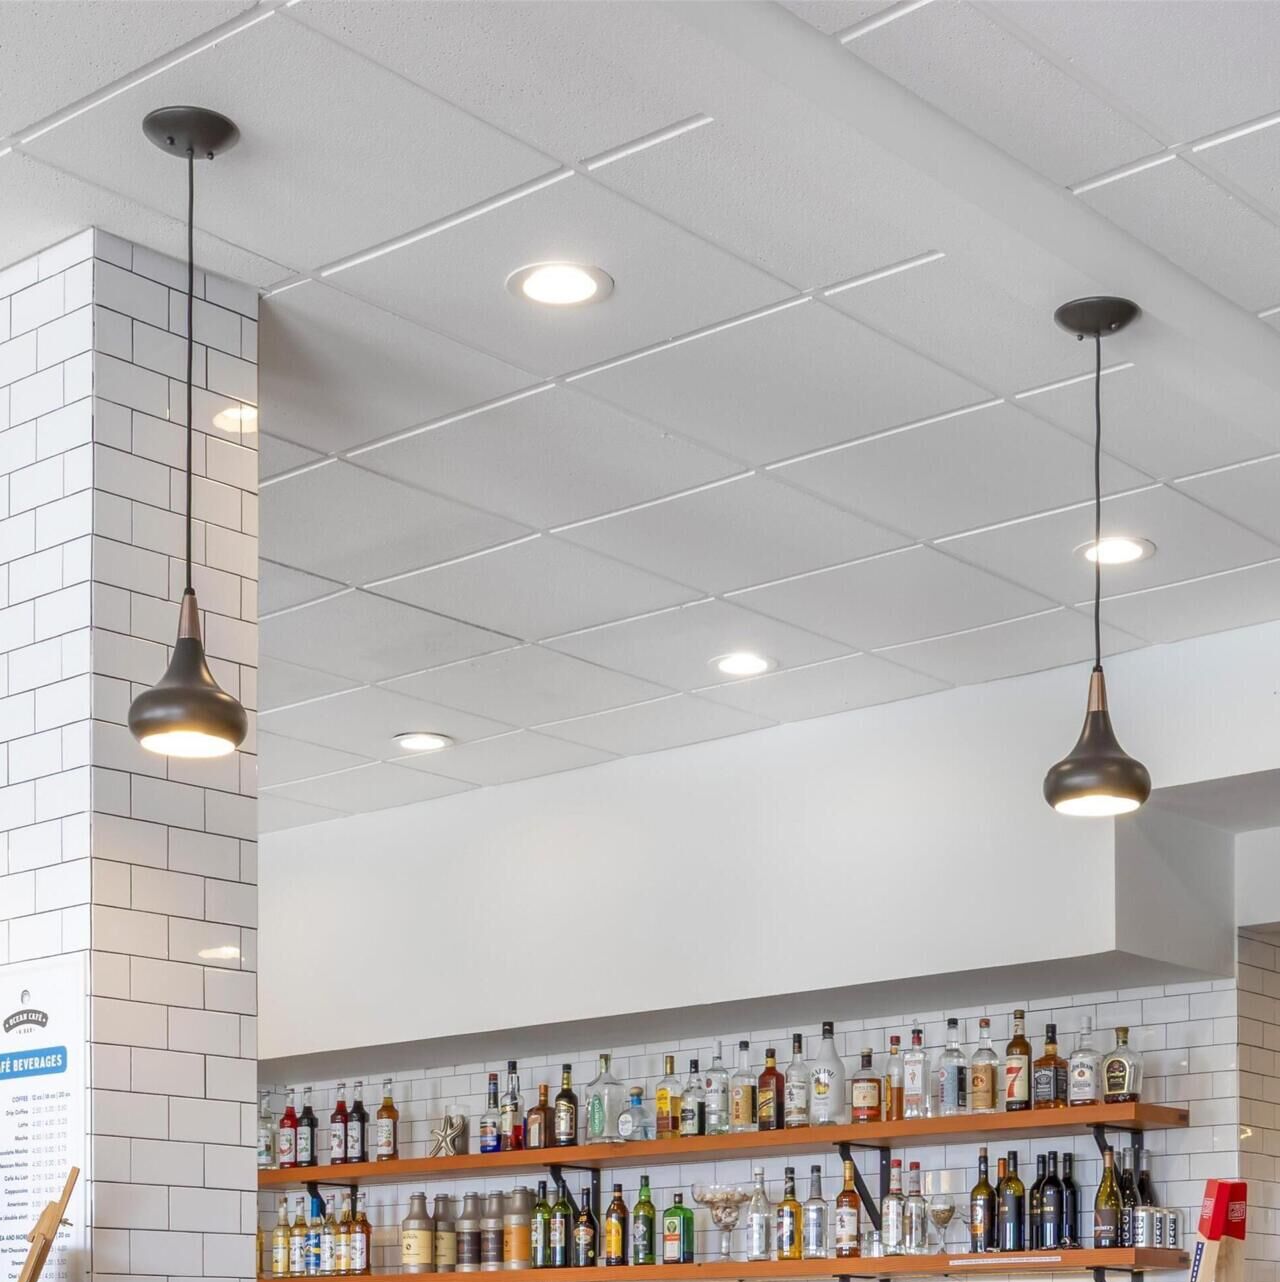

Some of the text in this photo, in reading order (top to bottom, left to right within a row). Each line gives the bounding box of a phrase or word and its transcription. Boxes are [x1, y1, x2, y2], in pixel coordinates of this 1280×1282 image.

[10, 1012, 42, 1025] OCEAN CAFÉ
[13, 1054, 62, 1071] BEVERAGES
[1080, 1062, 1093, 1072] BEAM
[1006, 1067, 1022, 1098] 7
